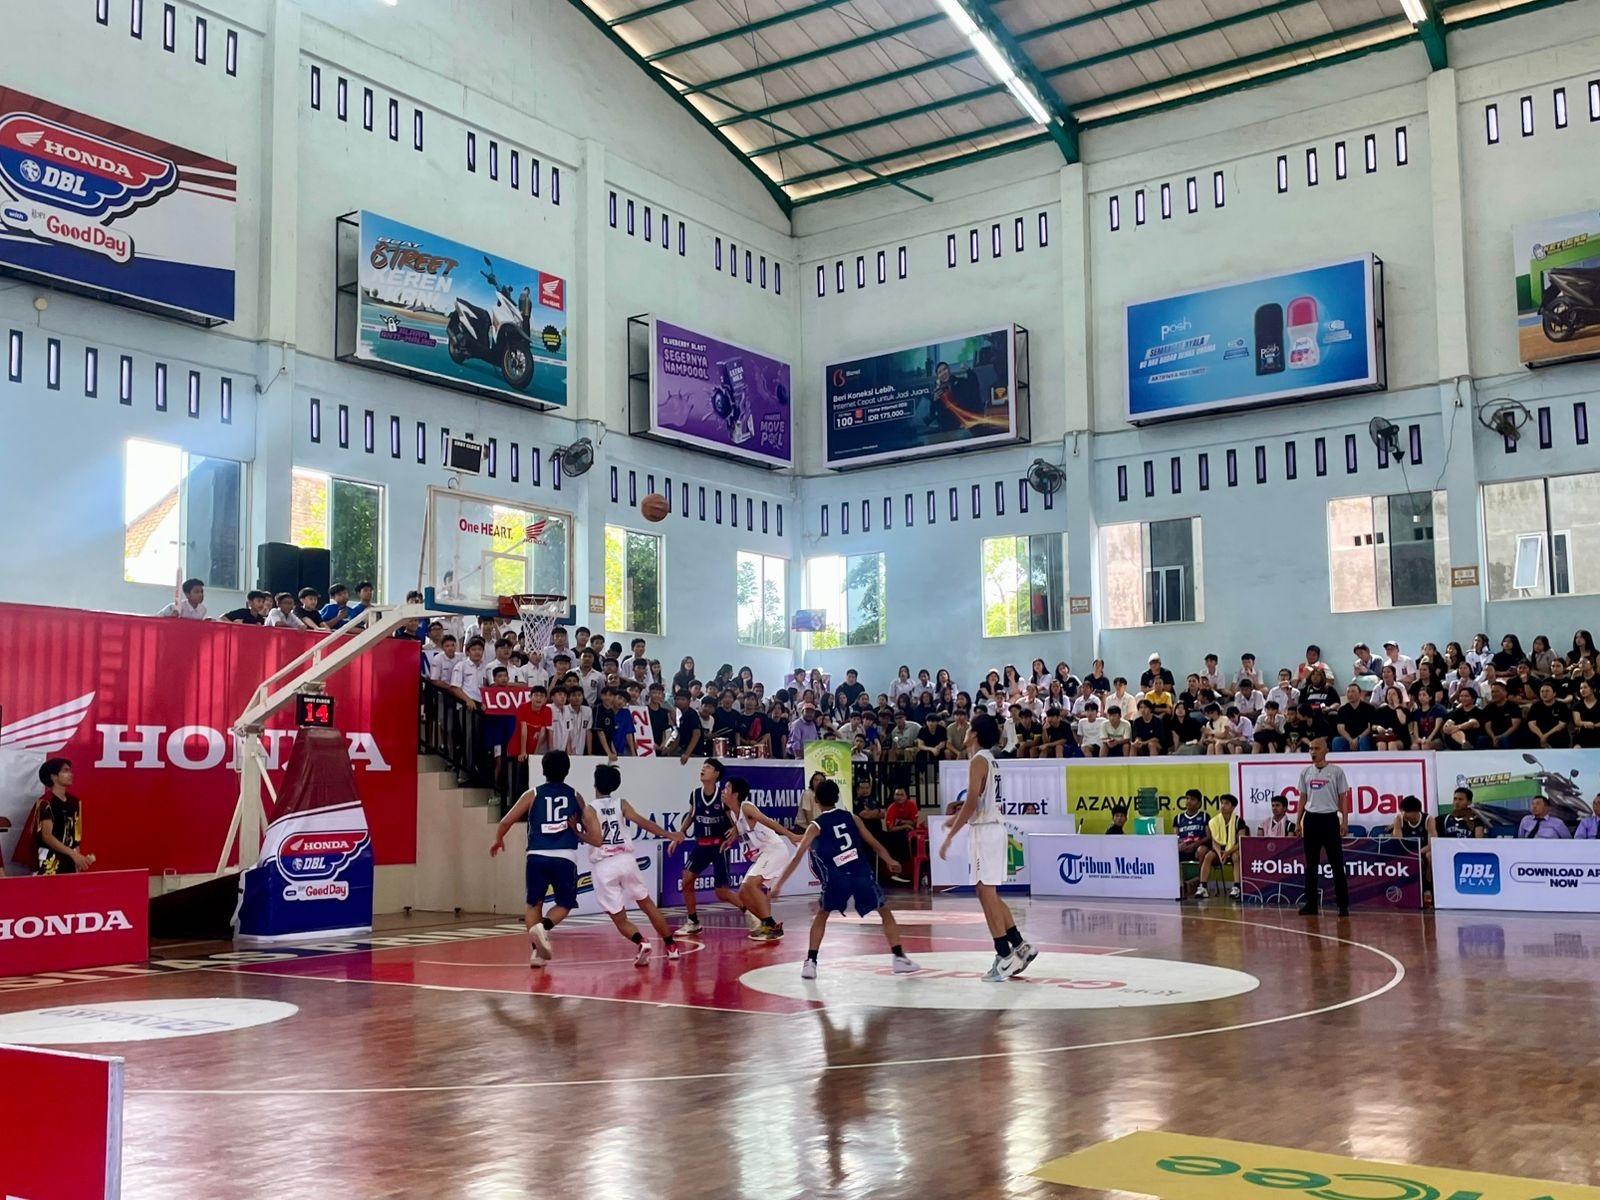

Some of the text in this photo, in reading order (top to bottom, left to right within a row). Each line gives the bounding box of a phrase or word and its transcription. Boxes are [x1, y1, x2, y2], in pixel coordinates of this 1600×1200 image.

[44, 139, 133, 179] HONDA
[41, 166, 87, 197] DBL
[370, 241, 459, 276] STREET
[1161, 316, 1192, 340] posh
[664, 348, 708, 368] SEGERNYA
[1261, 344, 1280, 359] posh
[833, 394, 846, 403] Beri
[847, 389, 874, 400] Koneksi
[833, 401, 856, 411] Internet
[857, 397, 876, 407] Cepat
[836, 417, 853, 428] 100
[868, 414, 879, 422] IDR
[760, 421, 785, 433] MOVE
[459, 519, 479, 532] One
[305, 703, 328, 722] 14
[95, 724, 391, 771] HONA
[1466, 772, 1511, 784] KEYLESS
[545, 796, 569, 822] 12
[602, 821, 624, 845] 22
[833, 823, 852, 851] 5
[303, 841, 349, 851] HONDA
[302, 857, 326, 870] DBL
[1057, 853, 1155, 884] Tribun Medan
[1459, 863, 1495, 878] DBL
[1517, 867, 1584, 878] DOWNLOAD
[1459, 878, 1494, 886] PLAY
[1550, 878, 1578, 888] NOW
[305, 885, 329, 896] Good
[329, 884, 347, 897] Day
